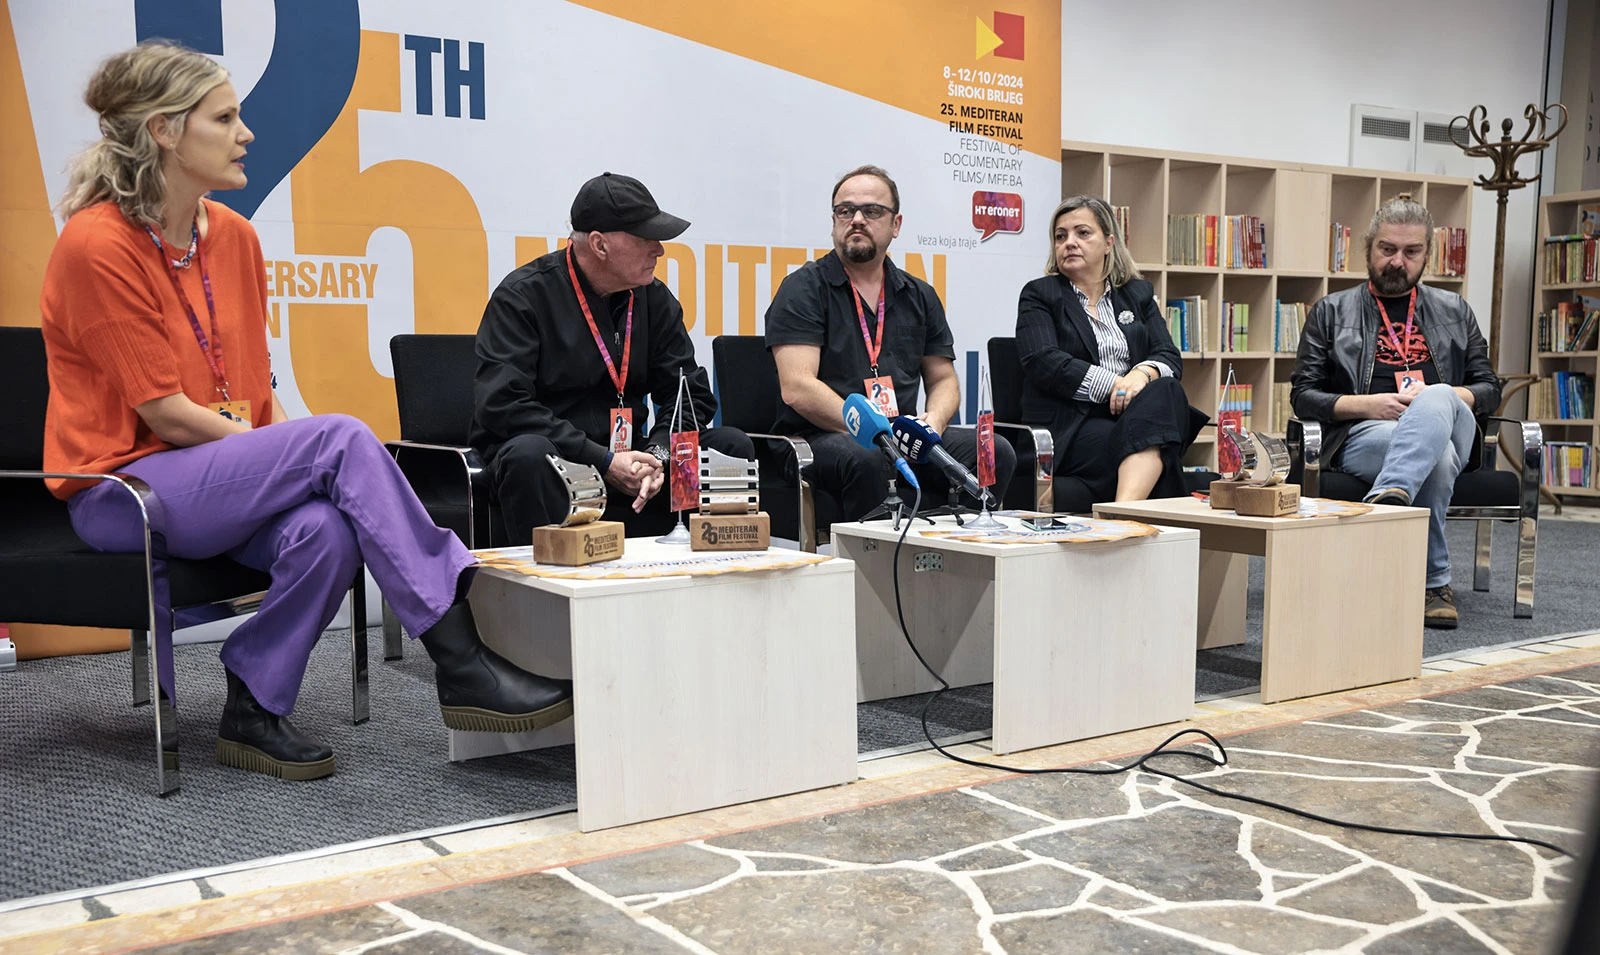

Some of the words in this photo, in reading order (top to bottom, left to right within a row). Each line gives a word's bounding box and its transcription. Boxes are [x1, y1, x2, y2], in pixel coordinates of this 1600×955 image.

[948, 80, 985, 100] ŠIROKI
[987, 88, 1023, 105] BRIJEG
[941, 103, 957, 116] 25.
[960, 105, 1023, 124] MEDITERAN
[949, 120, 974, 134] FILM
[977, 123, 1023, 140] FESTIVAL
[960, 138, 1006, 154] FESTIVAL
[1008, 143, 1023, 155] OF
[944, 152, 1023, 171] DOCUMENTARY
[988, 173, 1023, 187] MFF.BA
[917, 235, 937, 246] Veza
[939, 235, 957, 249] koja
[958, 237, 977, 250] traje
[718, 525, 759, 534] MEDITERAN
